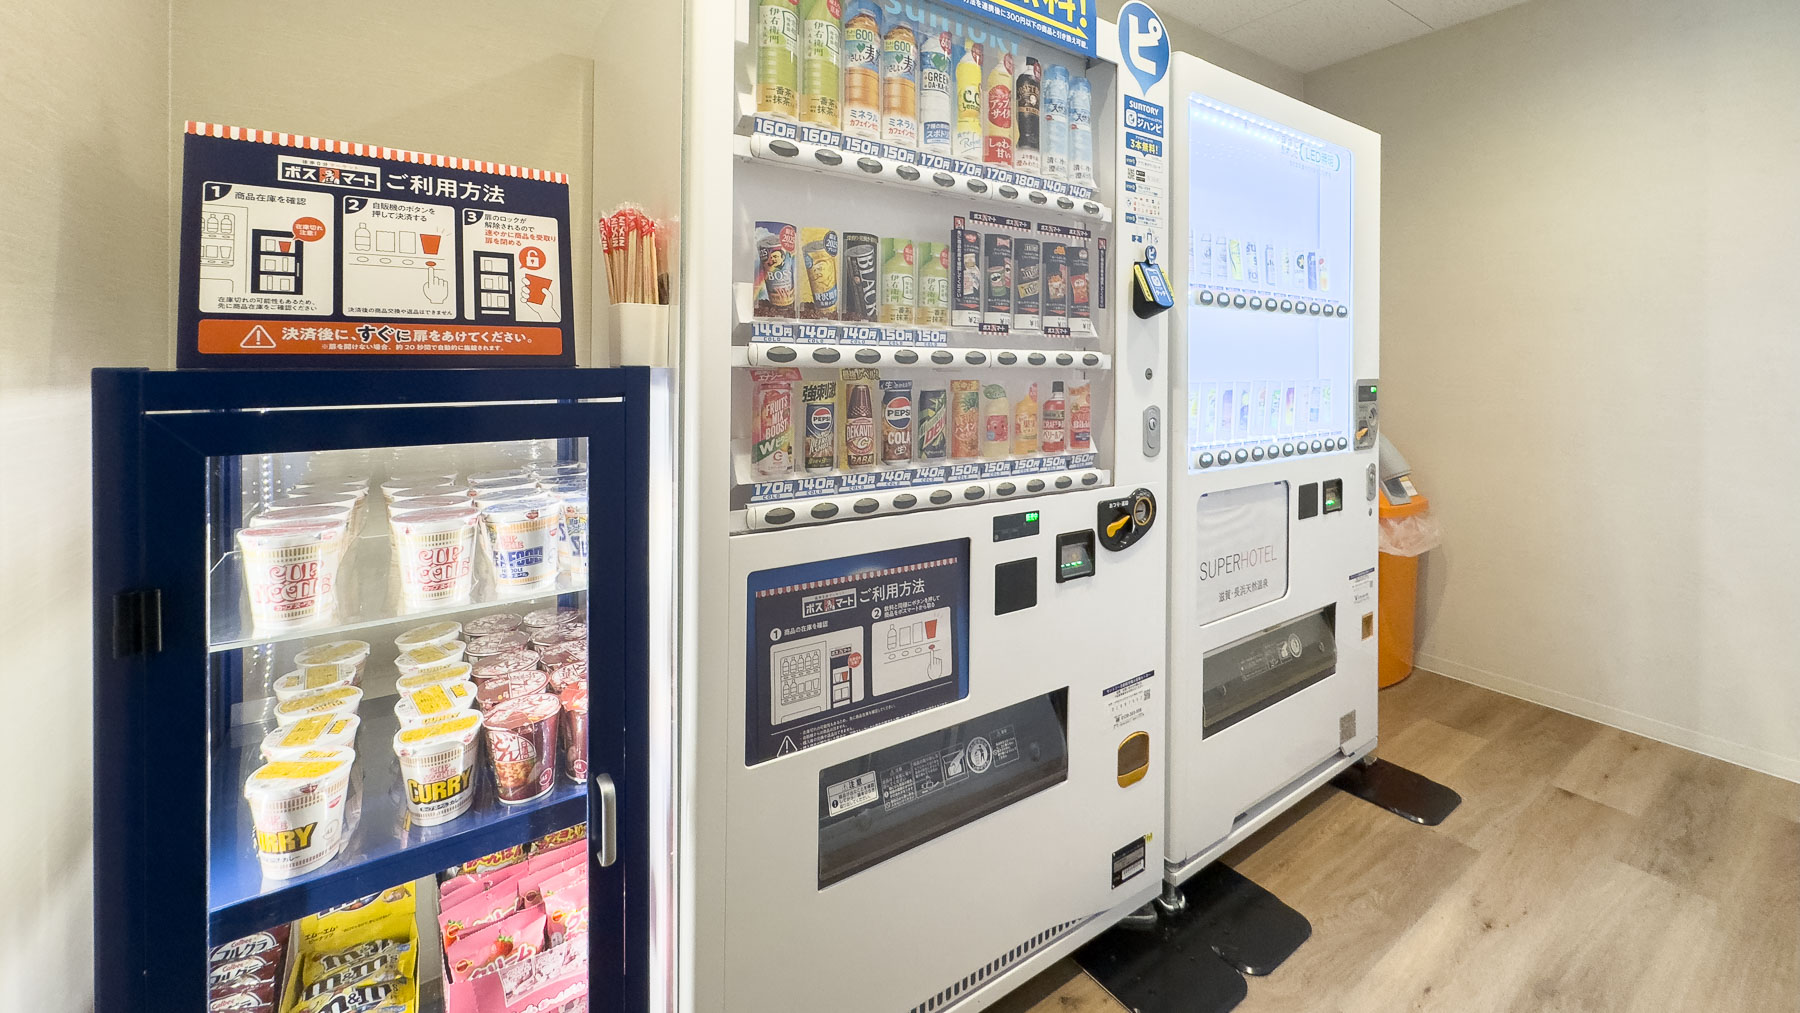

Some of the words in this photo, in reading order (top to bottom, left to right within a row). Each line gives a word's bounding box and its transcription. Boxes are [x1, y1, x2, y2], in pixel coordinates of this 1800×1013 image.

[855, 29, 873, 42] 600
[894, 40, 911, 53] 600
[1128, 13, 1162, 76] ピ
[1129, 100, 1159, 116] SUNTORY
[756, 119, 796, 139] 160円
[803, 128, 840, 146] 160円
[845, 138, 880, 156] 150円
[883, 146, 915, 164] 150円
[920, 153, 950, 170] 170円
[954, 161, 982, 177] 170円
[986, 167, 1013, 183] 170円
[285, 165, 317, 181] ボス
[341, 171, 375, 187] マート
[386, 172, 505, 205] ご利用方法
[1015, 173, 1040, 188] 180円
[1043, 179, 1067, 194] 140円
[211, 185, 221, 198] 1
[1069, 184, 1092, 199] 140円
[234, 191, 307, 206] 商品在庫を確認
[349, 200, 360, 211] 2
[372, 202, 436, 216] 自販機のボタンを
[371, 210, 428, 222] 押して決済する
[467, 211, 477, 222] 3
[484, 213, 527, 224] 扉のロックが
[295, 223, 324, 231] 在庫切れ
[484, 221, 535, 233] 解除されるので
[484, 229, 557, 242] 速やかに商品を受取り
[485, 237, 523, 247] 扉を閉める
[856, 255, 877, 317] BLACK
[217, 302, 318, 311] 先に商品在庫をご確認ください
[218, 296, 316, 305] 在庫切れの可能性もあるため、
[347, 306, 453, 317] 決済後の商品交換や返品はできません
[281, 324, 534, 344] 決済後に、すぐに扉をあけてください。
[753, 323, 793, 337] 140円
[799, 325, 836, 338] 140円
[843, 327, 877, 339] 140円
[881, 329, 912, 340] 150円
[917, 330, 946, 341] 150円
[765, 395, 788, 417] FRUITS
[772, 411, 783, 424] MIX
[765, 419, 788, 440] BOOST
[984, 462, 1010, 472] 150円
[1014, 459, 1040, 469] 150円
[1042, 457, 1066, 467] 150円
[880, 470, 911, 482] 140円
[916, 467, 945, 478] 140円
[951, 465, 979, 476] 150円
[798, 479, 834, 490] 140円
[842, 474, 876, 486] 140円
[755, 482, 793, 496] 170円
[1199, 545, 1278, 581] SUPERHOTEL
[806, 602, 824, 614] ボス
[835, 596, 854, 608] マート
[860, 578, 925, 604] ご利用方法
[784, 620, 829, 636] 商品の在庫を確認
[407, 765, 473, 804] CURRY
